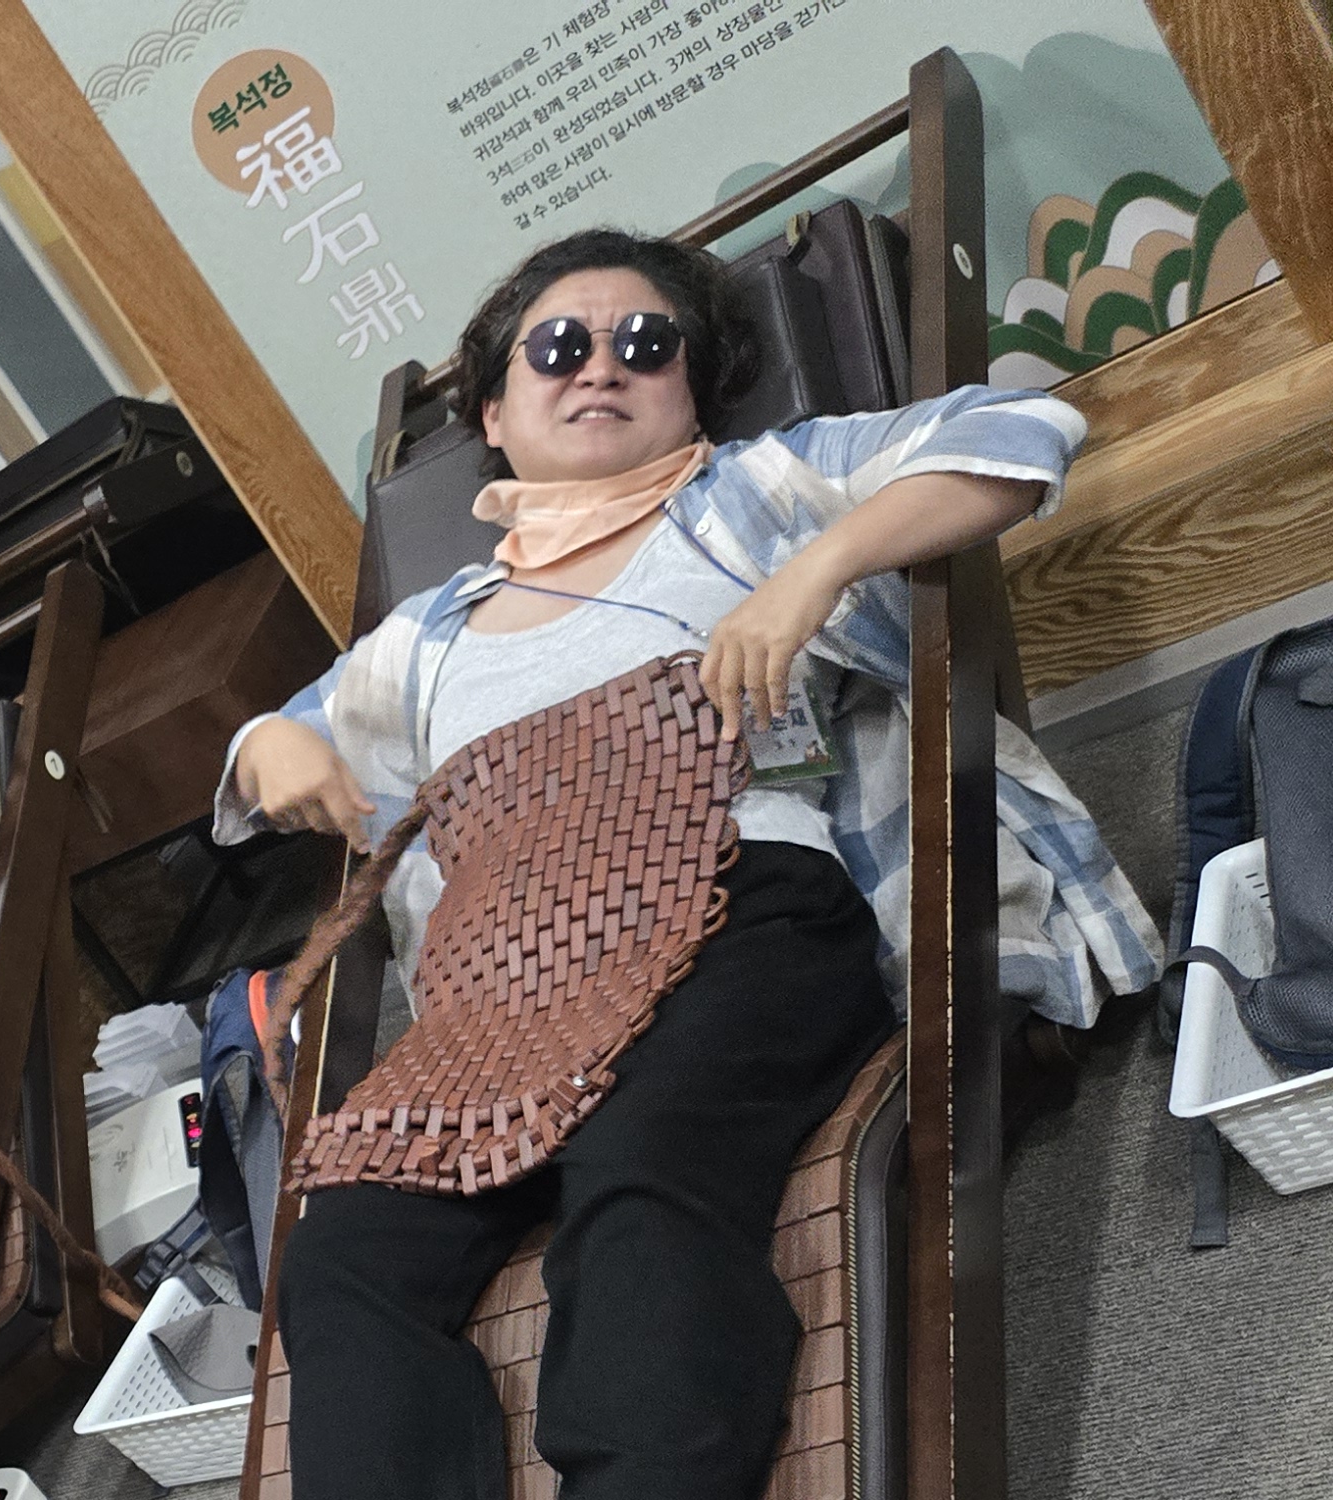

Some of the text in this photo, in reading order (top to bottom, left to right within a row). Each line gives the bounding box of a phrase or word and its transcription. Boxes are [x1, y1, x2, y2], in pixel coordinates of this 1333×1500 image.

[206, 61, 293, 135] 복석정
[446, 0, 610, 114] 복석정石은 기 체험장
[459, 0, 669, 137] 바위입니다. 이곳을 찾는 사람의
[473, 117, 532, 161] 귀감석과
[532, 95, 566, 125] 함께
[565, 74, 598, 102] 우리
[598, 43, 647, 82] 민족이
[646, 20, 682, 49] 가장
[500, 0, 846, 206] 하여 많은 사람이 일시에 방문할 경우 마당을 걷기
[553, 70, 662, 143] 완성되었습니다.
[665, 36, 712, 74] 3개의
[235, 105, 428, 361] 福石鼎
[513, 166, 612, 230] 갈 수 있습니다.
